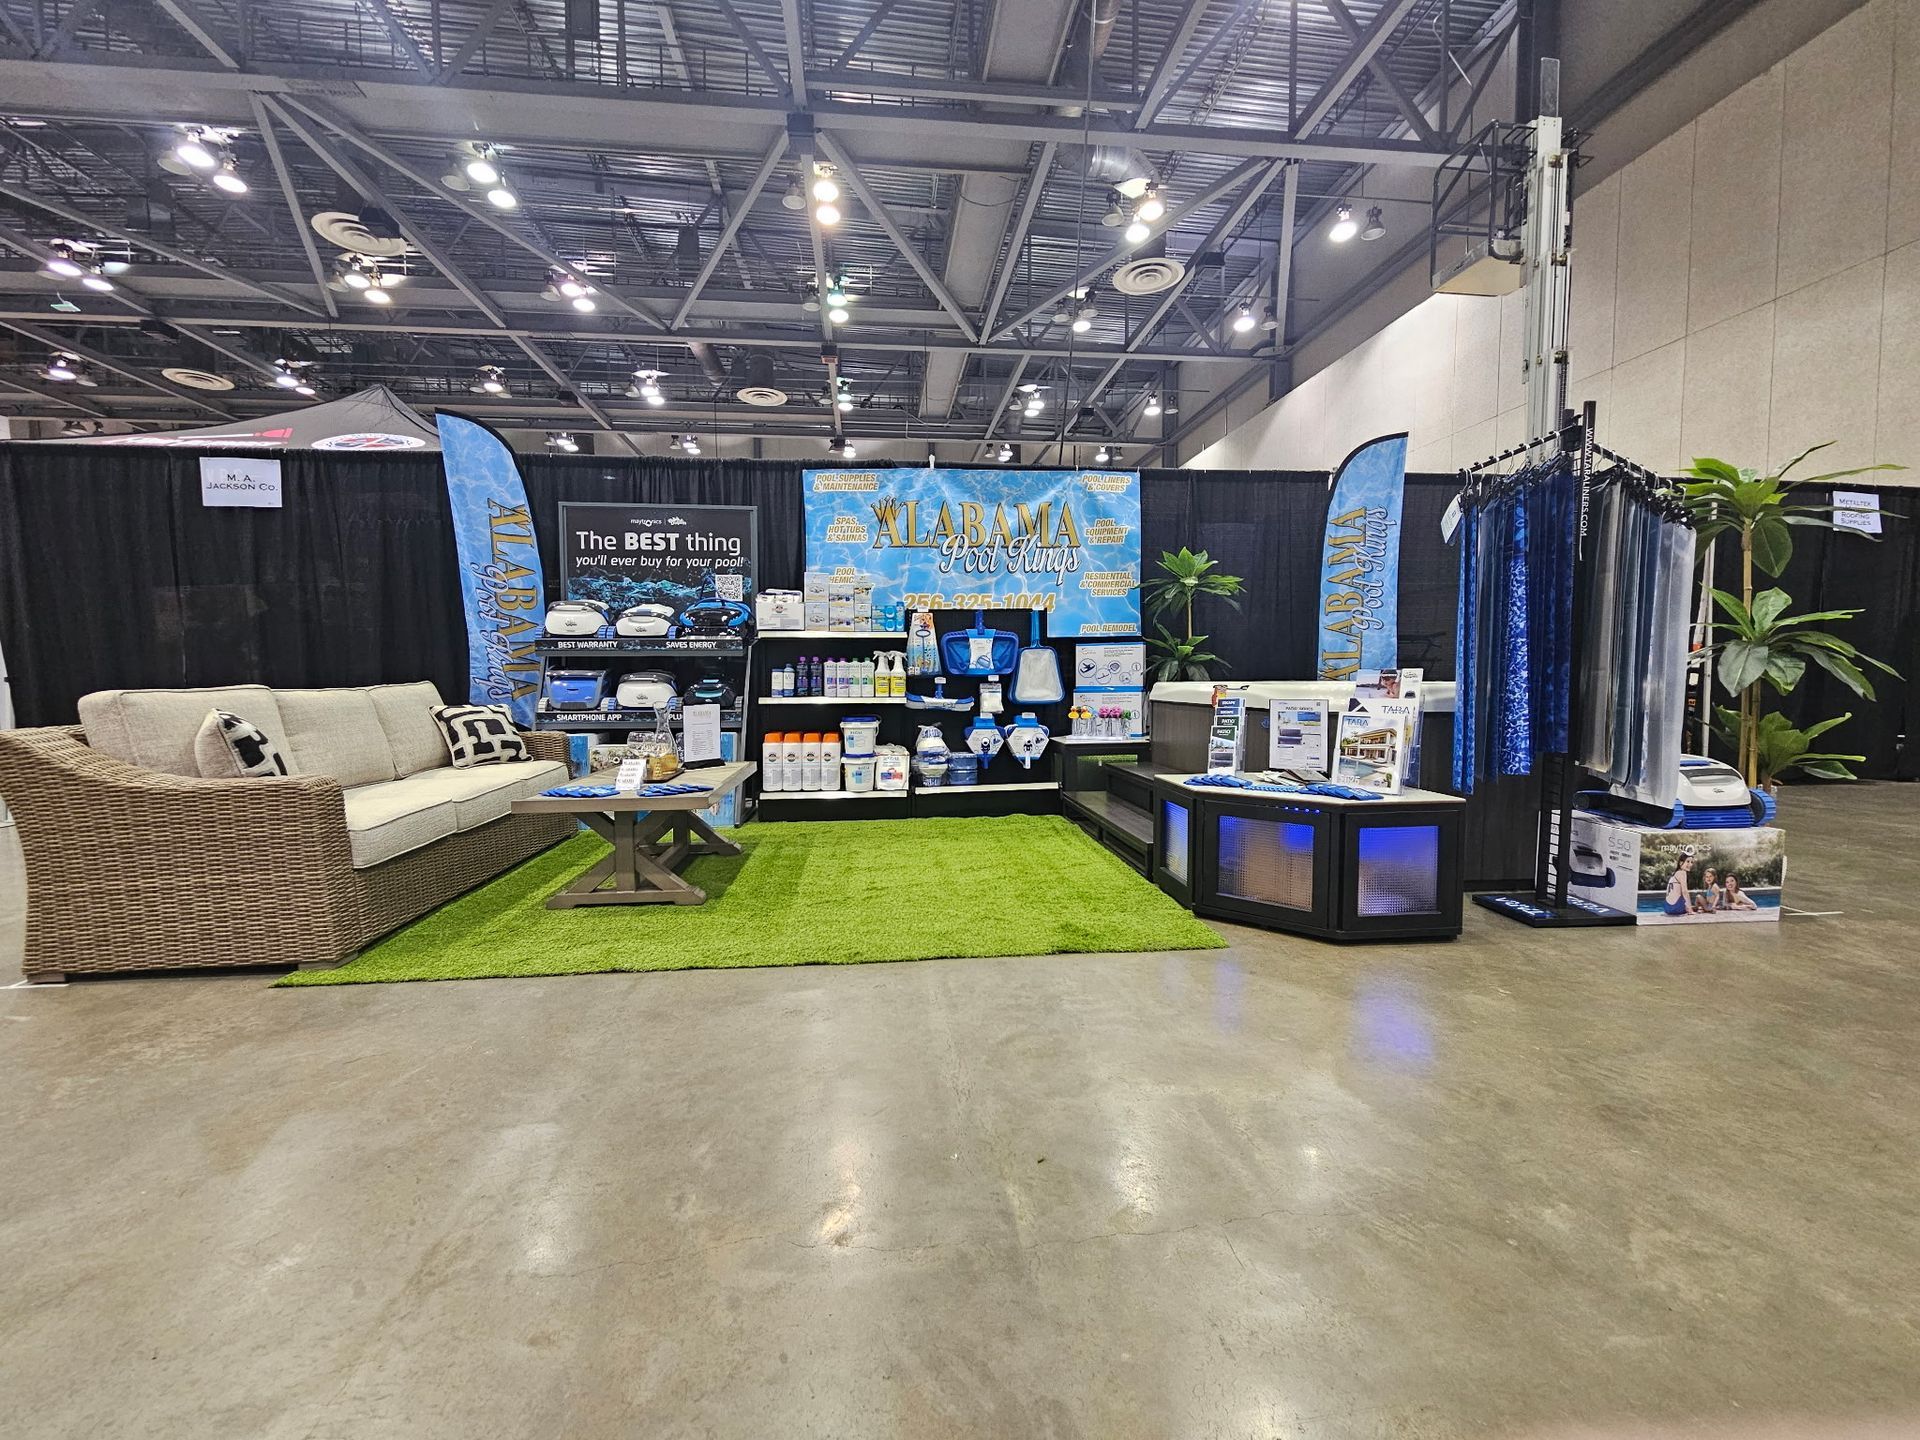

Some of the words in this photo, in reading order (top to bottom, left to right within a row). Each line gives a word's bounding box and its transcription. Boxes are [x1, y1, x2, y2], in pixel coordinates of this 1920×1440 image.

[227, 474, 240, 482] M.
[243, 474, 255, 482] A.
[816, 474, 837, 482] POOL
[840, 473, 876, 482] SUPPLIES
[1083, 475, 1102, 483] POOL
[1104, 476, 1130, 484] LINERS
[1580, 427, 1594, 537] WWW.TARALINERS.COM
[206, 482, 256, 491] JACKSON
[814, 483, 820, 491] &
[822, 482, 878, 491] MAINTENANCE
[1088, 483, 1094, 491] &
[835, 517, 858, 526] SPAS,
[872, 498, 1081, 549] ALABAMA
[1096, 519, 1115, 527] POOL
[828, 525, 844, 533] HOT
[846, 525, 866, 534] TUBS
[1085, 527, 1129, 536] EQUIPMENT
[835, 534, 868, 542] SAUNAS
[1096, 536, 1125, 544] REPAIR
[1353, 504, 1398, 573] Kings
[576, 530, 617, 550] The
[624, 531, 680, 551] BEST
[686, 532, 741, 556] thing
[575, 554, 607, 568] you'll
[610, 556, 638, 566] ever
[640, 555, 663, 568] buy
[665, 555, 683, 567] for
[686, 557, 712, 569] your
[714, 557, 744, 569] pool!
[939, 533, 1001, 574] Pool
[1006, 532, 1082, 587] Kings
[835, 567, 855, 575] POOL
[829, 576, 855, 584] HEMIC
[1084, 572, 1132, 580] RESIDENTIAL
[1080, 580, 1086, 588] &
[1087, 580, 1136, 588] COMMERCIAL
[470, 562, 509, 623] Pool
[1092, 588, 1127, 596] SERVICES
[487, 498, 541, 701] ALABAMA
[903, 592, 1056, 613] 256-325-1044
[1351, 579, 1385, 631] Pool
[1102, 624, 1137, 632] REMODEL
[557, 641, 575, 649] BEST
[577, 641, 618, 649] WARRANTY
[666, 641, 688, 649] SAVES
[689, 641, 717, 649] ENERGY
[1382, 705, 1410, 715] TARA
[1347, 718, 1369, 727] TARA
